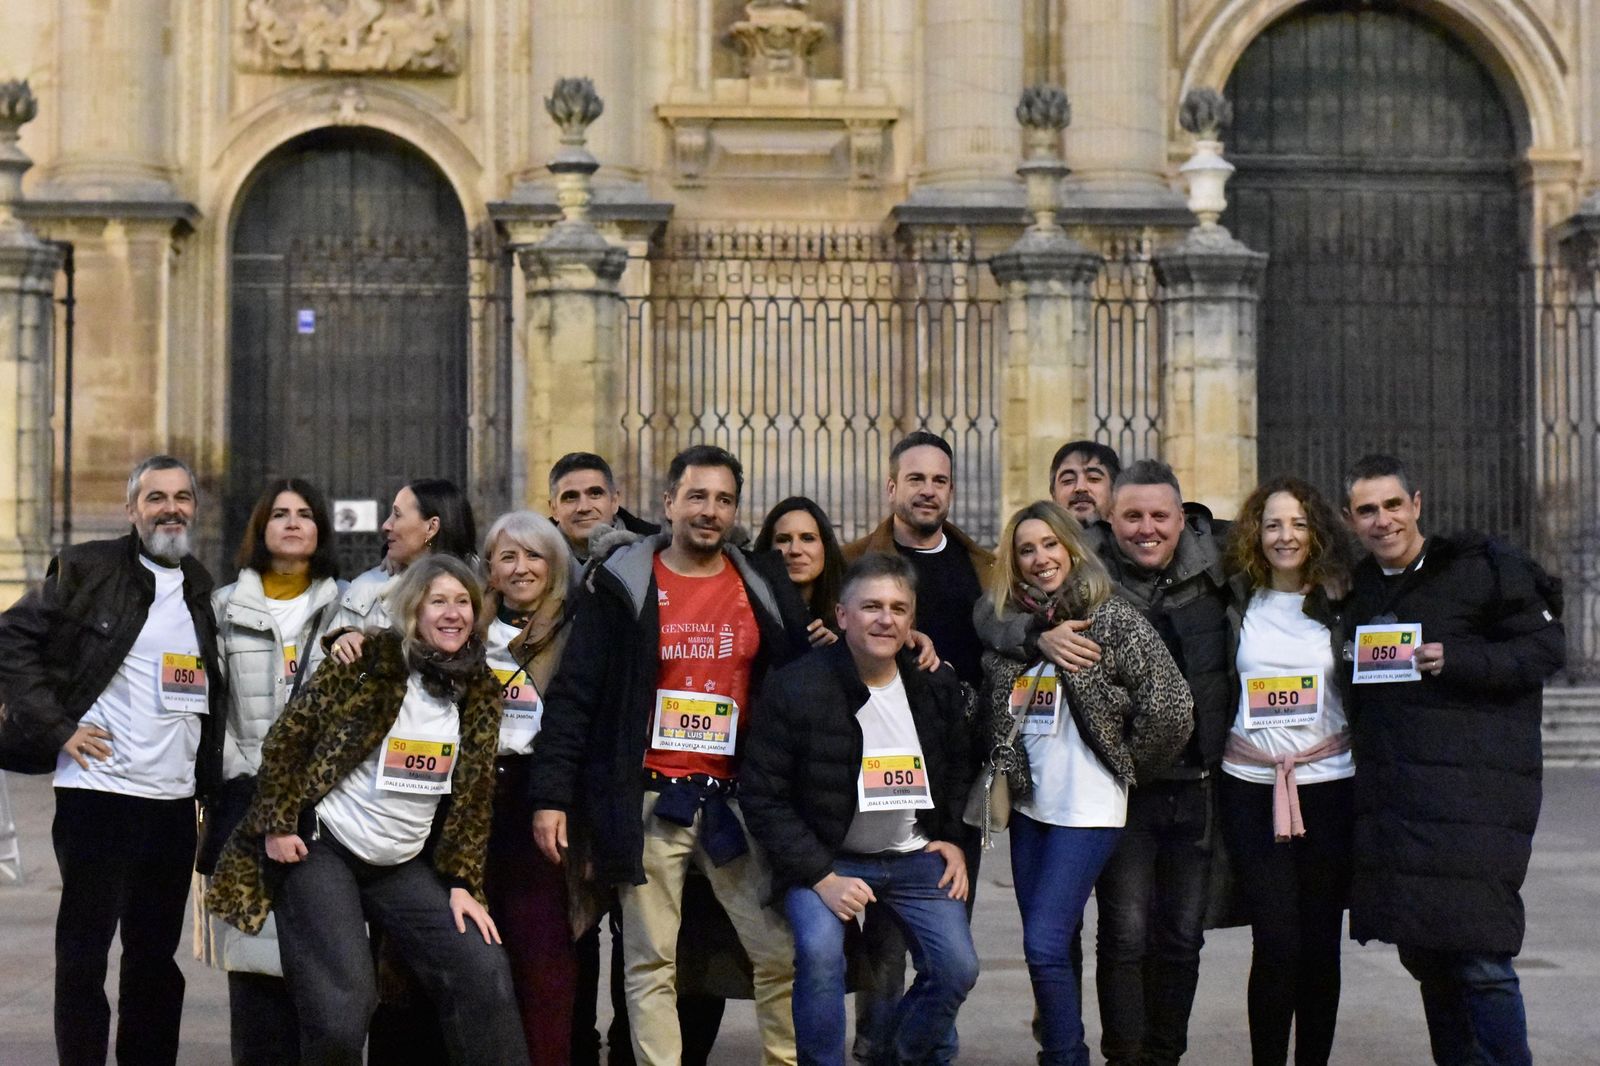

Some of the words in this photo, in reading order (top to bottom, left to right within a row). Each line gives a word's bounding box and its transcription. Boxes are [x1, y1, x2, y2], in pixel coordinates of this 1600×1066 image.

[661, 623, 715, 634] GENERALI
[688, 635, 715, 644] MARATÓN
[1362, 635, 1373, 645] 50
[661, 641, 715, 660] MÁLAGA
[1372, 646, 1397, 660] 050
[174, 668, 195, 684] 050
[1016, 679, 1028, 688] 50
[1252, 681, 1265, 690] 50
[1268, 691, 1299, 706] 050
[666, 700, 679, 710] 50
[680, 713, 712, 731] 050
[687, 731, 703, 739] LUIS
[393, 741, 406, 751] 50
[405, 755, 436, 771] 050
[867, 760, 880, 769] 50
[884, 770, 914, 786] 050
